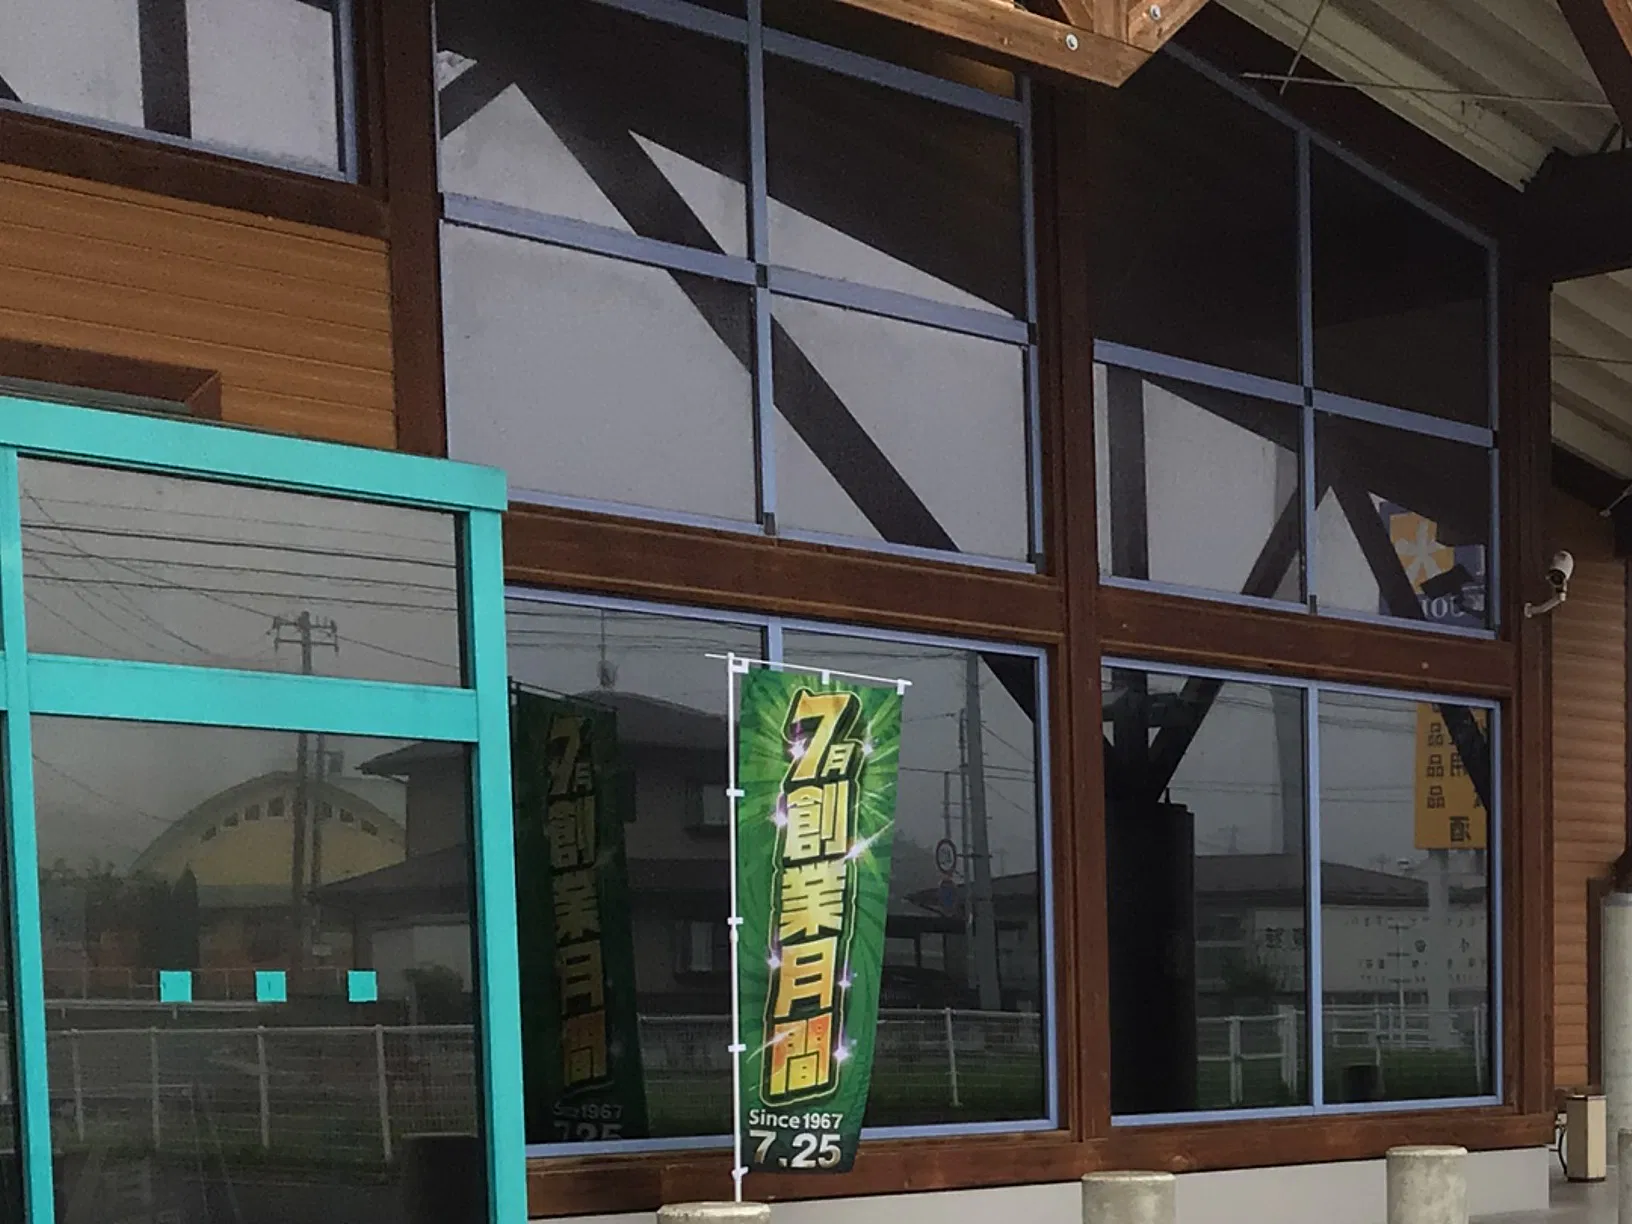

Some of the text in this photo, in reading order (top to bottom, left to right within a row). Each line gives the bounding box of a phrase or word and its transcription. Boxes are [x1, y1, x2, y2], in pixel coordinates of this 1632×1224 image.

[748, 1108, 843, 1130] Since 1967
[749, 1129, 842, 1169] 7.25
